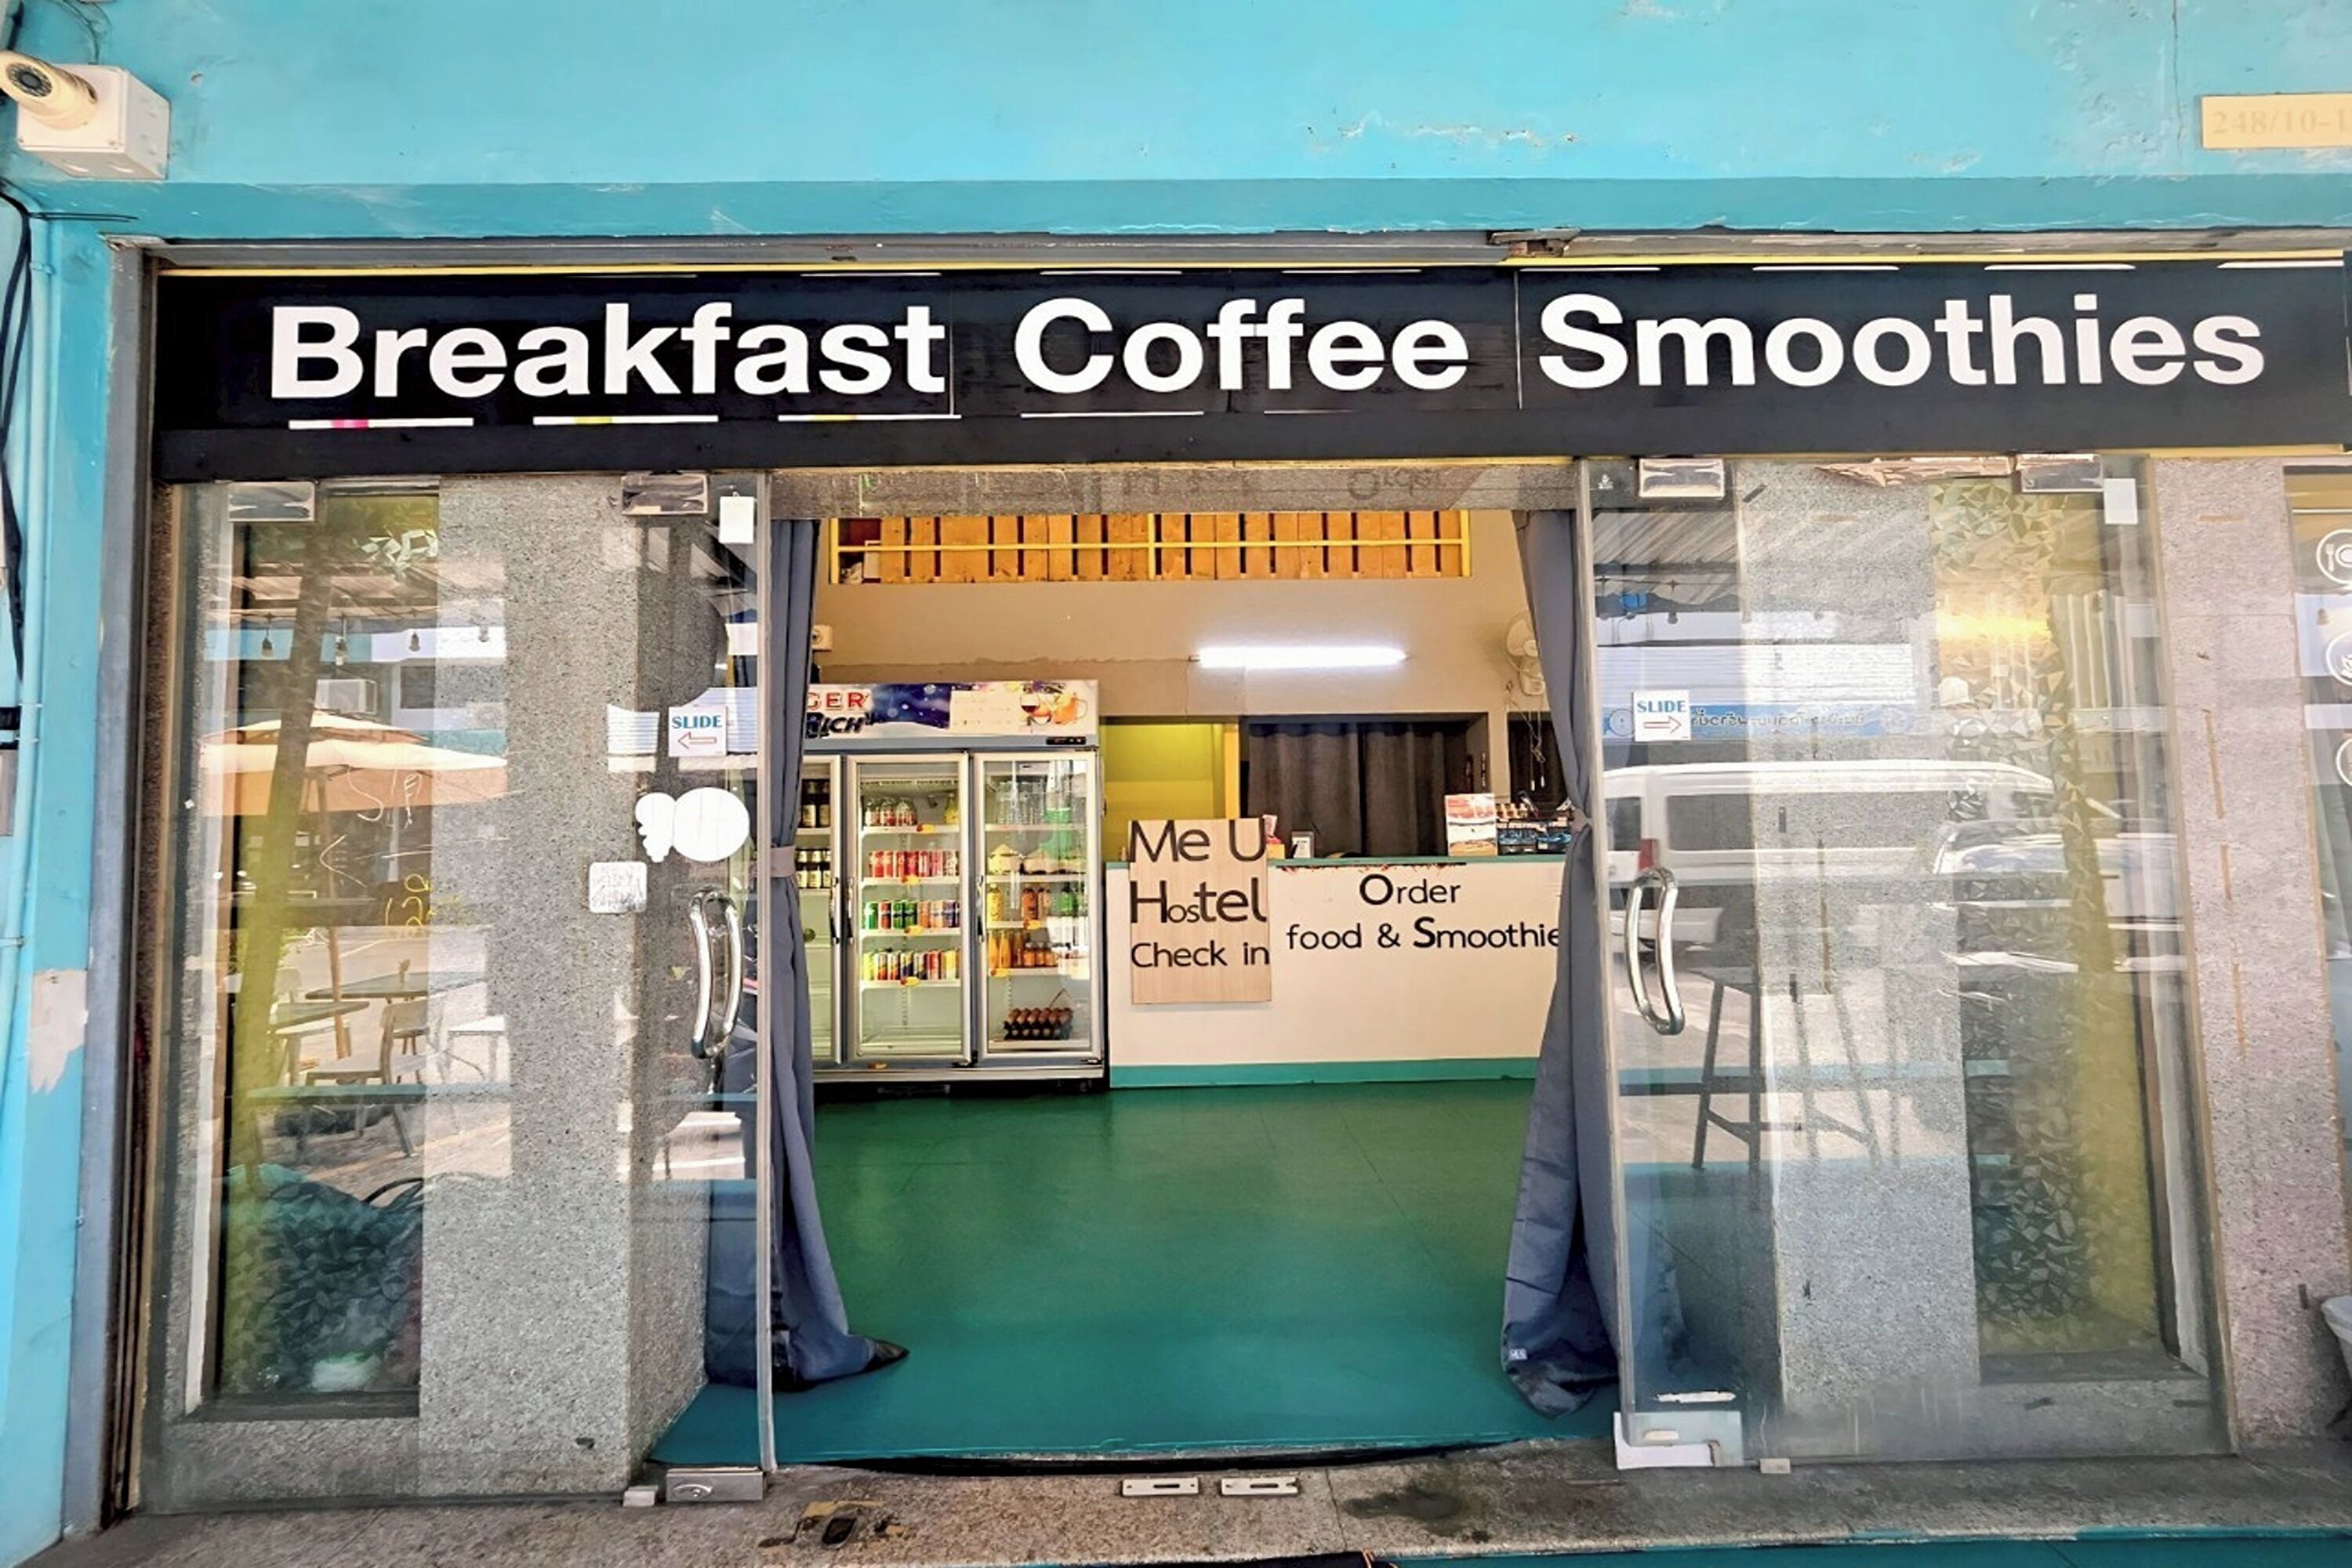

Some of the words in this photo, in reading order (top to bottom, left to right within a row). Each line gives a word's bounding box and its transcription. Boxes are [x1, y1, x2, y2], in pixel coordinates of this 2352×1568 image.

[270, 302, 945, 399] Breakfast
[1014, 296, 1469, 394] Coffee
[1539, 293, 2265, 388] Smoothies
[672, 714, 723, 729] SLIDE
[1636, 700, 1687, 713] SLIDE
[1127, 819, 1210, 862] Me
[1229, 818, 1268, 862] U
[1130, 877, 1268, 924] Hostel
[1359, 873, 1461, 905] Order
[1287, 922, 1363, 949] food
[1377, 923, 1401, 949] &
[1131, 939, 1228, 968] Check
[1243, 942, 1271, 966] in
